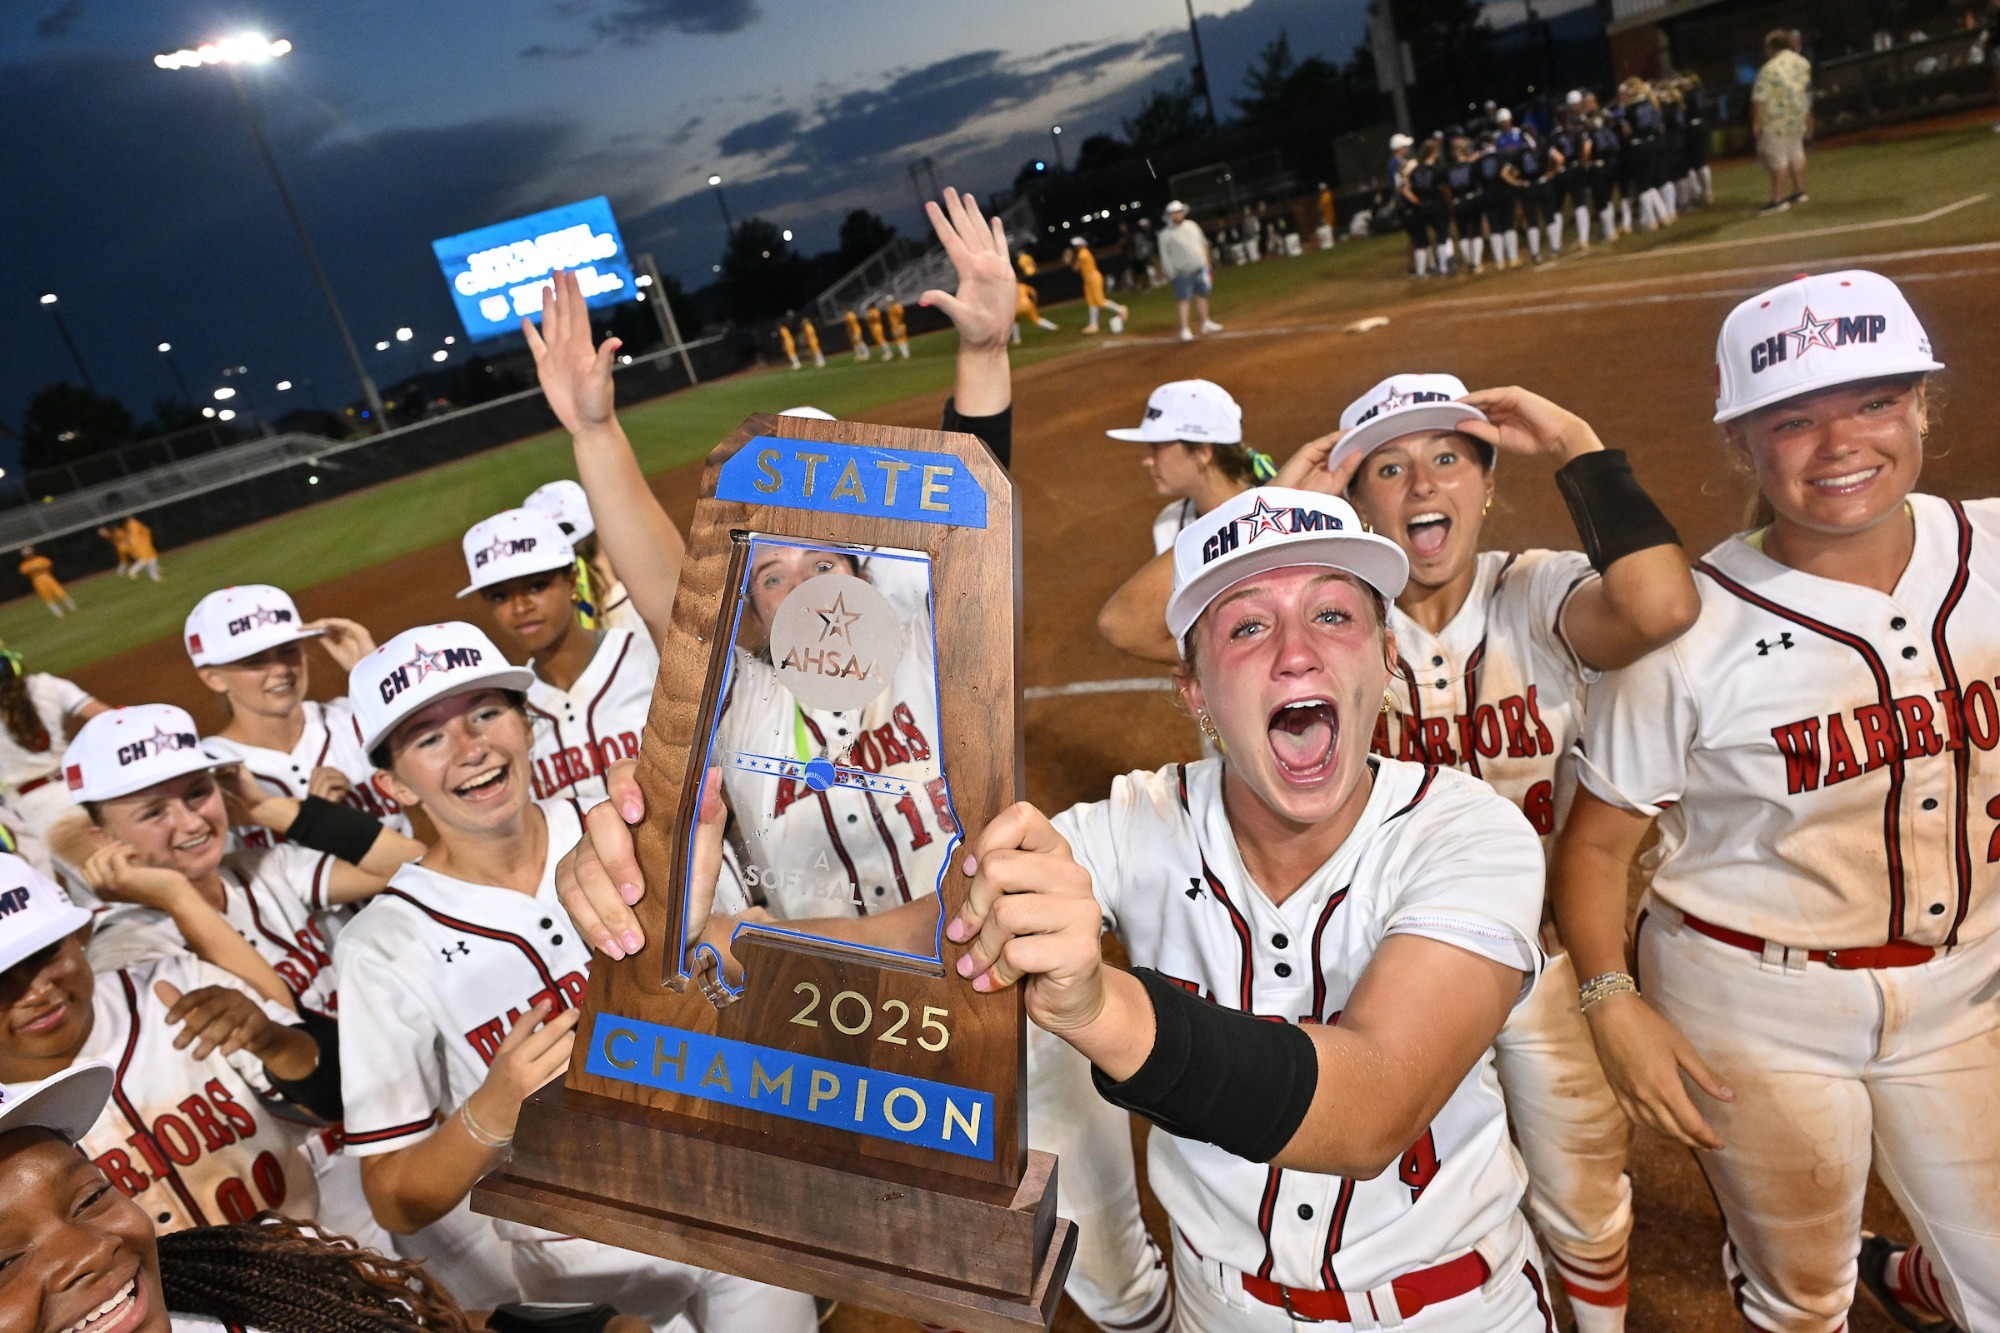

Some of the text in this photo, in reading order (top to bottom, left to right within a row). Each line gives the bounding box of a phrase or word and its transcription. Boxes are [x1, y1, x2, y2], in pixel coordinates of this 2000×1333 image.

[1751, 306, 1886, 365] CHAMP
[753, 449, 954, 513] STATE
[379, 643, 482, 705] CHAMP
[1370, 684, 1554, 767] ARRIORS
[1771, 678, 2000, 796] WARRIO
[0, 886, 30, 920] MP
[744, 864, 878, 908] SOFTBALL
[789, 982, 951, 1052] 2025
[603, 1028, 983, 1147] CHAMPION
[94, 1077, 257, 1199] RIORS
